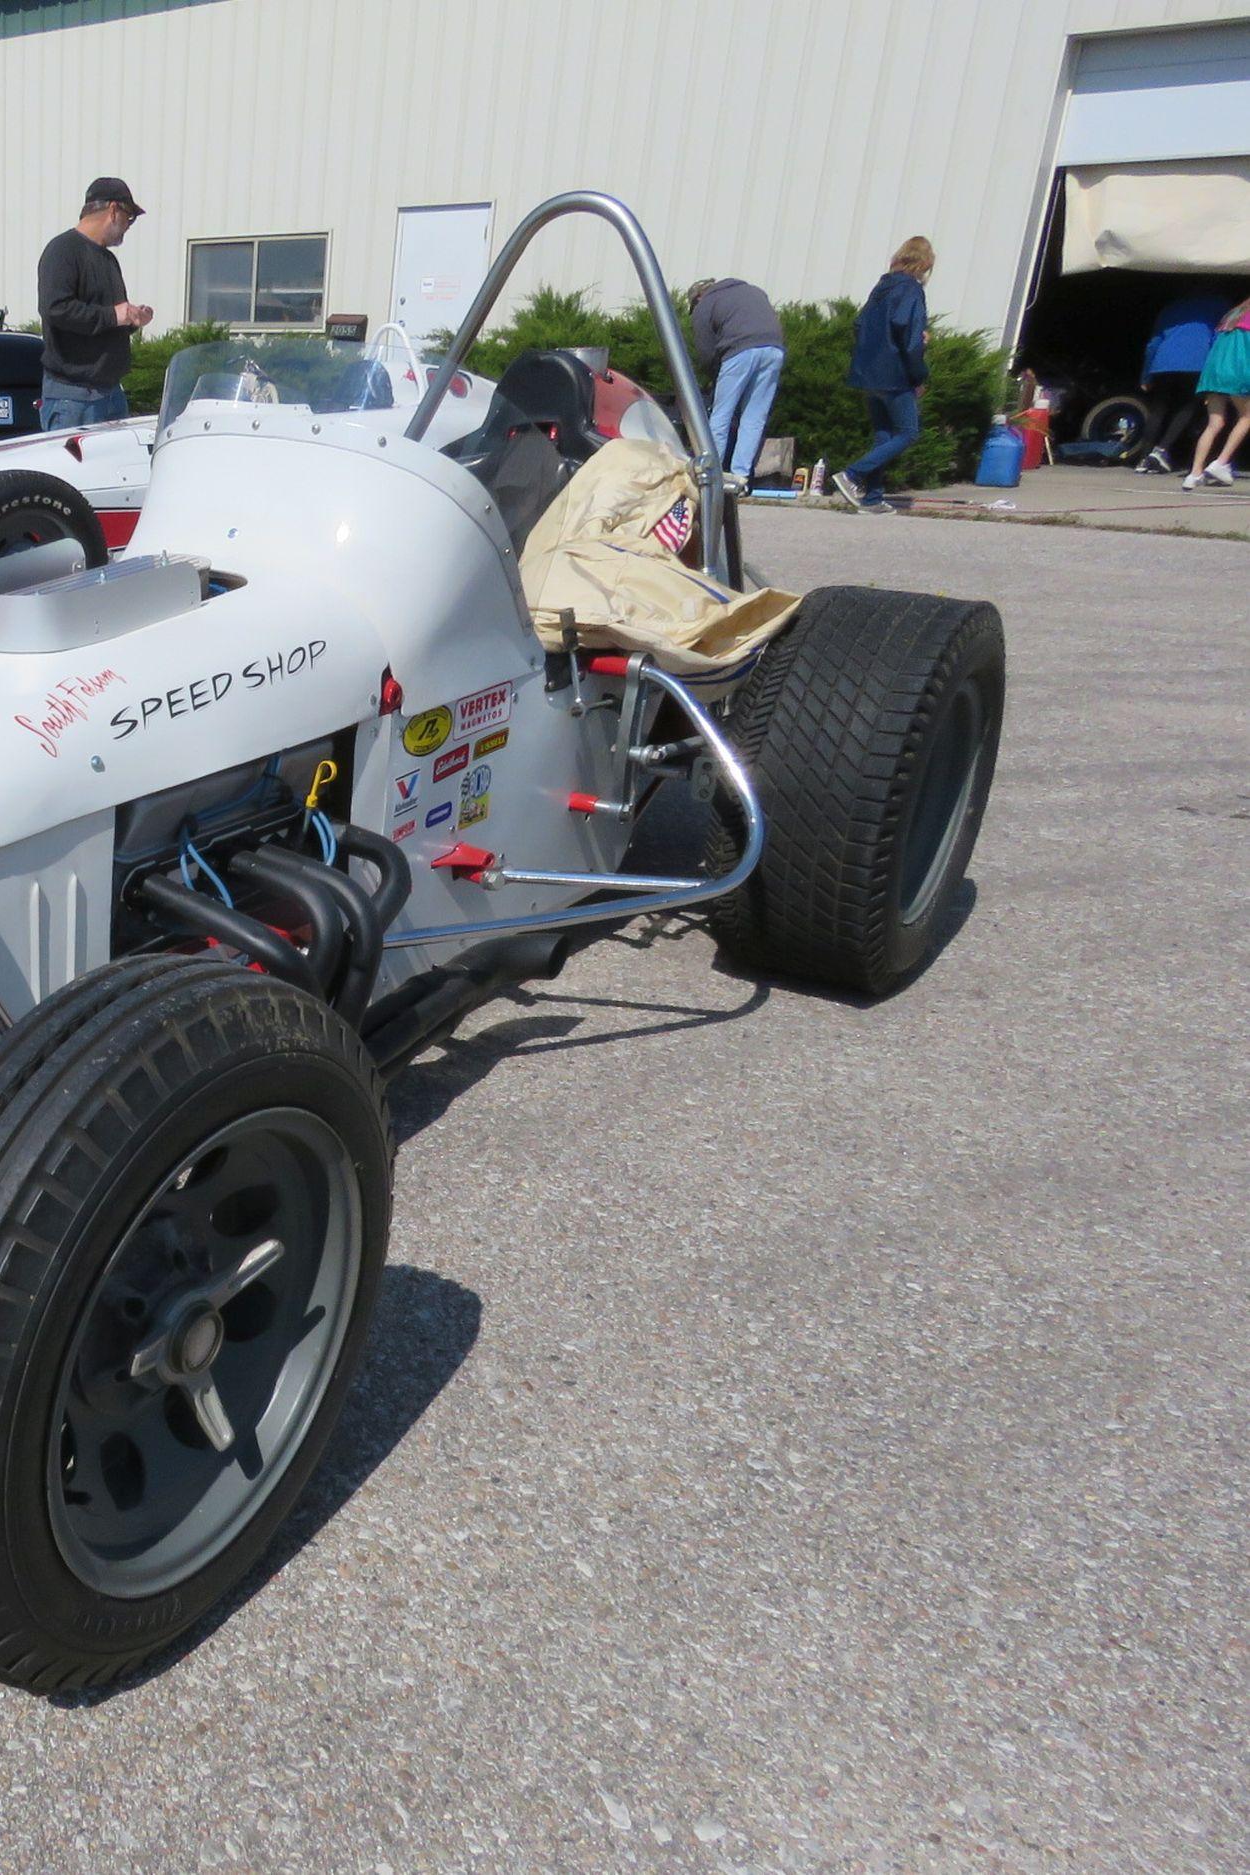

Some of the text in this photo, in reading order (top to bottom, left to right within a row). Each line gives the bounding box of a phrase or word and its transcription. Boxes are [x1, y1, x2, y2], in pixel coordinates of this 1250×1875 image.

[109, 639, 327, 740] SPEED SHOP
[460, 688, 507, 720] VERTEX
[461, 707, 503, 730] MAGNETOS
